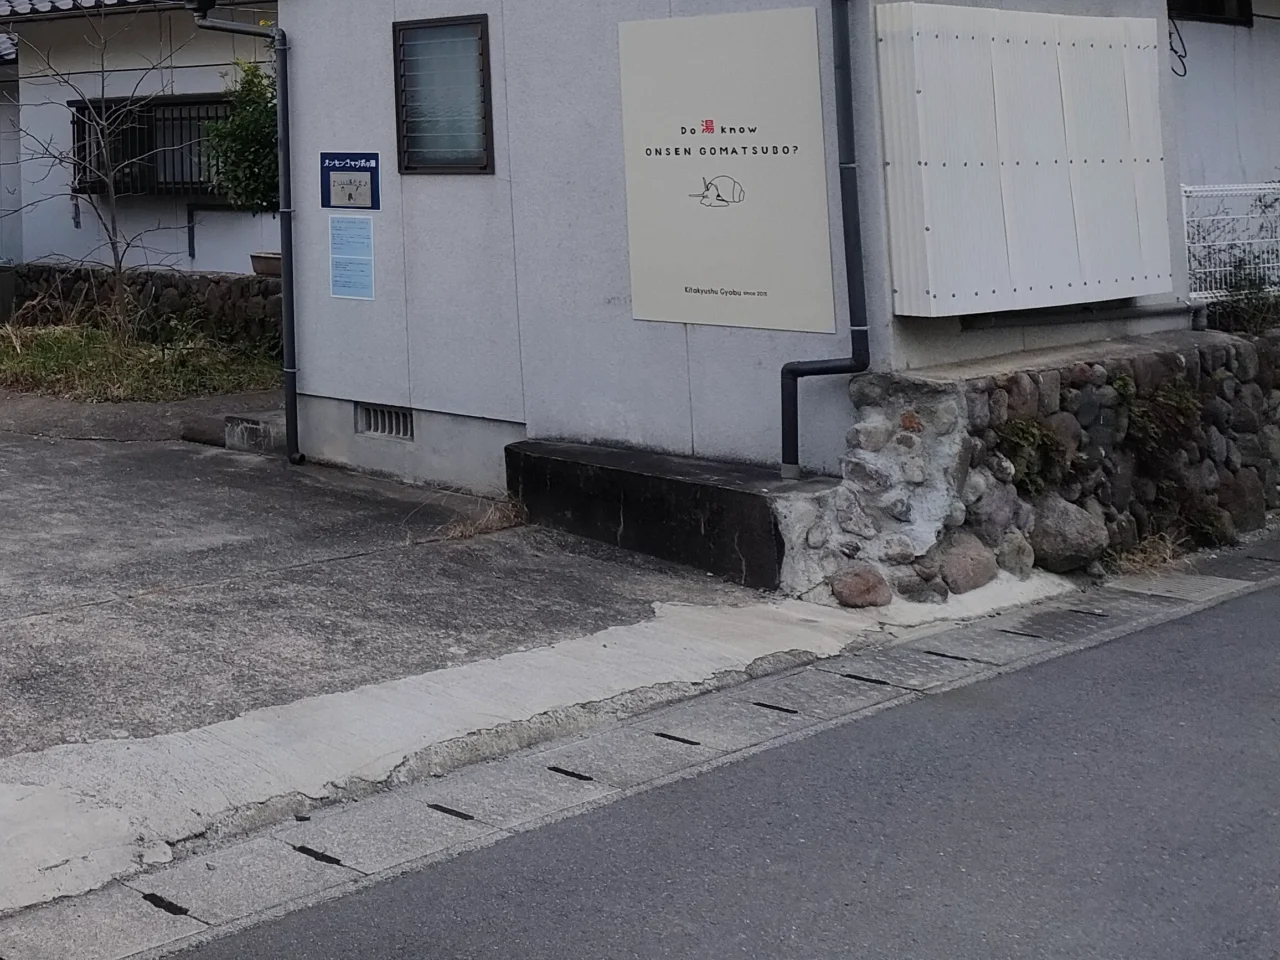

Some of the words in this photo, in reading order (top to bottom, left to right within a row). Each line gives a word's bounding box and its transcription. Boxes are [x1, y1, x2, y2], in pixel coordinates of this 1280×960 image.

[680, 126, 697, 135] Do
[701, 119, 715, 134] 湯
[720, 126, 758, 134] know
[645, 147, 692, 156] ONSEN
[699, 145, 799, 156] GOMATSUBO?
[684, 286, 719, 295] Kitakyushu
[719, 288, 742, 296] Gyobu
